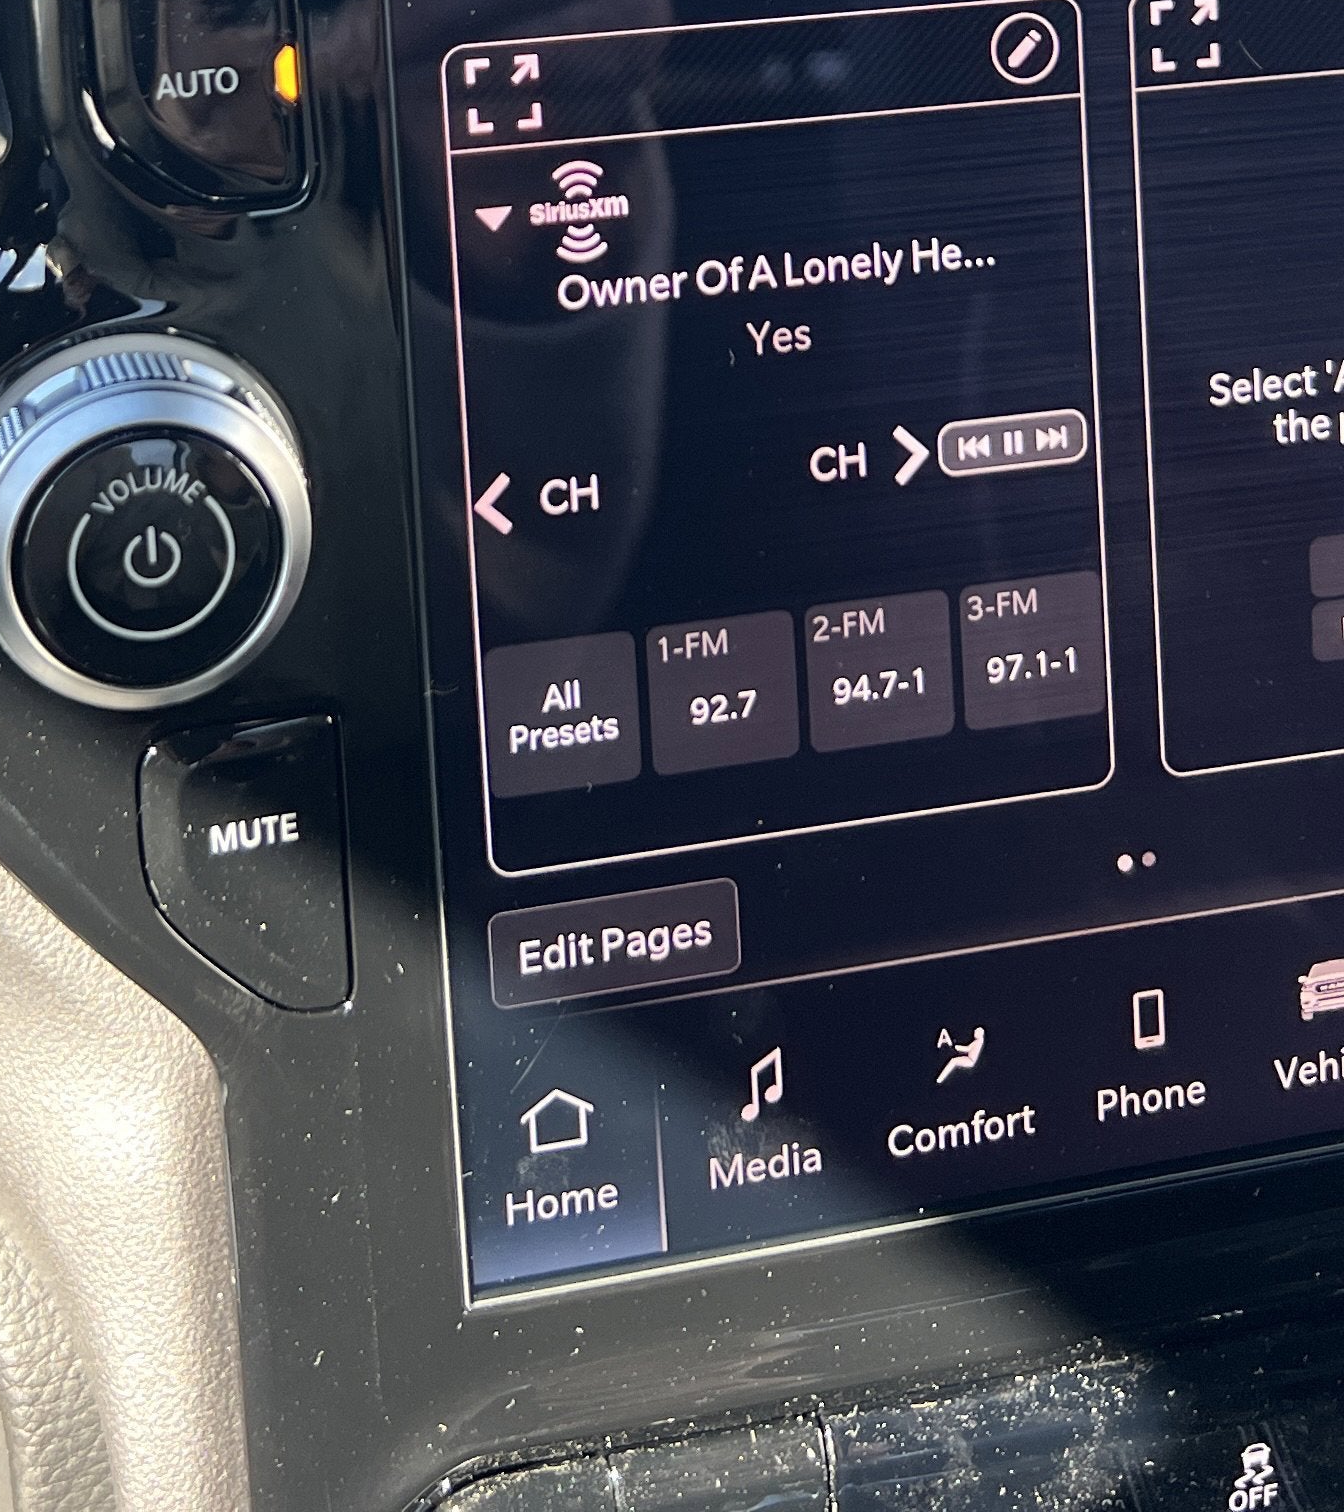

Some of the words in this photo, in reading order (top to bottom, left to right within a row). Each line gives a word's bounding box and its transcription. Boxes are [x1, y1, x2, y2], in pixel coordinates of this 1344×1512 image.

[156, 66, 240, 100] AUTO
[557, 271, 687, 310] Owner
[695, 258, 744, 297] Of
[748, 256, 778, 290] A
[785, 243, 902, 288] Lonely
[747, 321, 812, 356] Yes
[1208, 363, 1317, 407] Select
[1272, 408, 1330, 446] the
[809, 442, 867, 484] CH
[90, 466, 207, 516] VOLUME
[540, 474, 599, 516] CH
[812, 608, 885, 642] 2-FM
[966, 588, 1038, 622] 3-FM
[657, 629, 728, 663] 1-FM
[985, 646, 1077, 684] 97.1-1
[542, 679, 582, 713] All
[832, 666, 926, 705] 94.7-1
[689, 690, 757, 727] 92.7
[508, 714, 620, 755] Presets
[209, 813, 298, 855] MUTE
[518, 932, 595, 976] Edit
[602, 915, 713, 968] Pages
[1096, 1078, 1207, 1121] Phone
[887, 1104, 1036, 1159] Comfort
[708, 1142, 823, 1190] Media
[505, 1181, 619, 1227] Home
[1228, 1483, 1278, 1512] OFF
